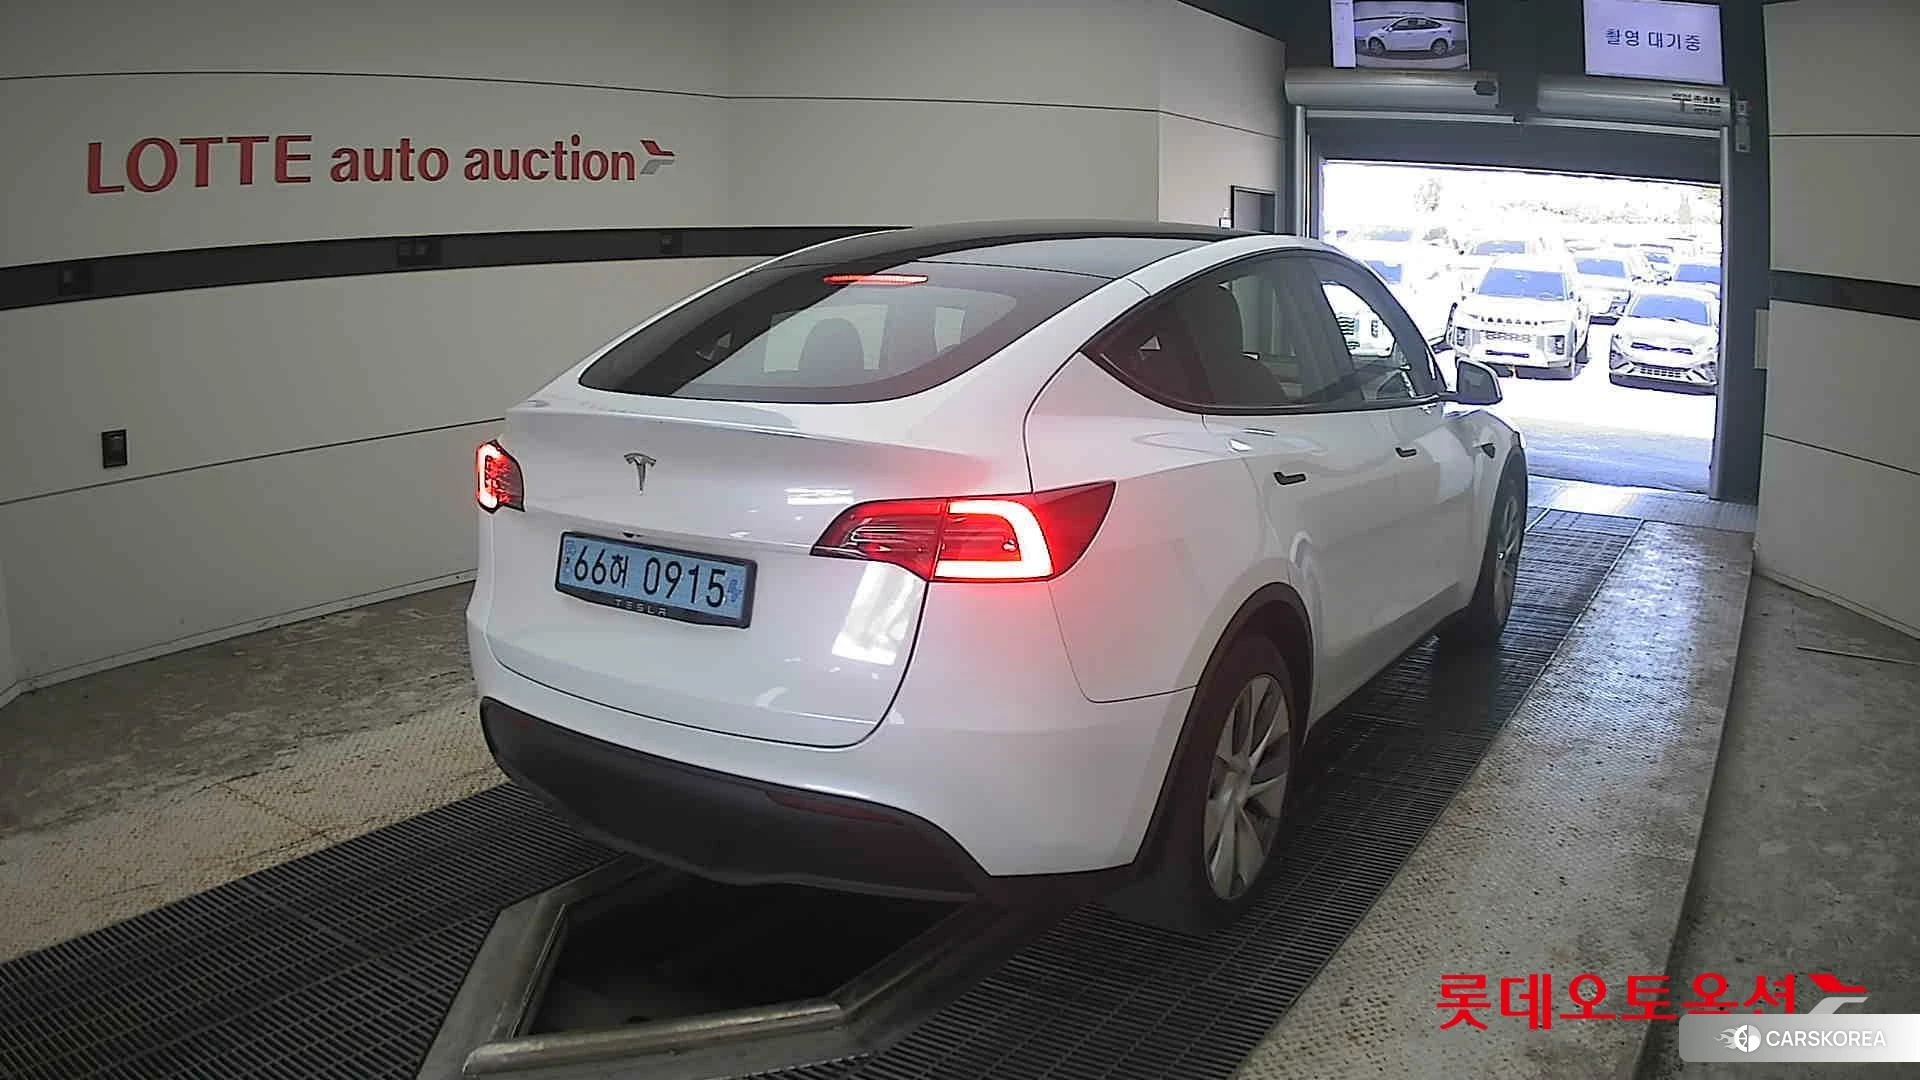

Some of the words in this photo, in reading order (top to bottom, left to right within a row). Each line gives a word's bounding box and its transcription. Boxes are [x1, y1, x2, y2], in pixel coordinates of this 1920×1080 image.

[1606, 28, 1639, 47] 촬영
[1648, 31, 1701, 52] 대기중
[87, 135, 312, 194] LOTTE
[330, 137, 449, 183] auto
[464, 134, 636, 182] auction
[574, 545, 629, 588] 66허
[643, 557, 727, 608] 0915
[614, 598, 668, 617] TESLA
